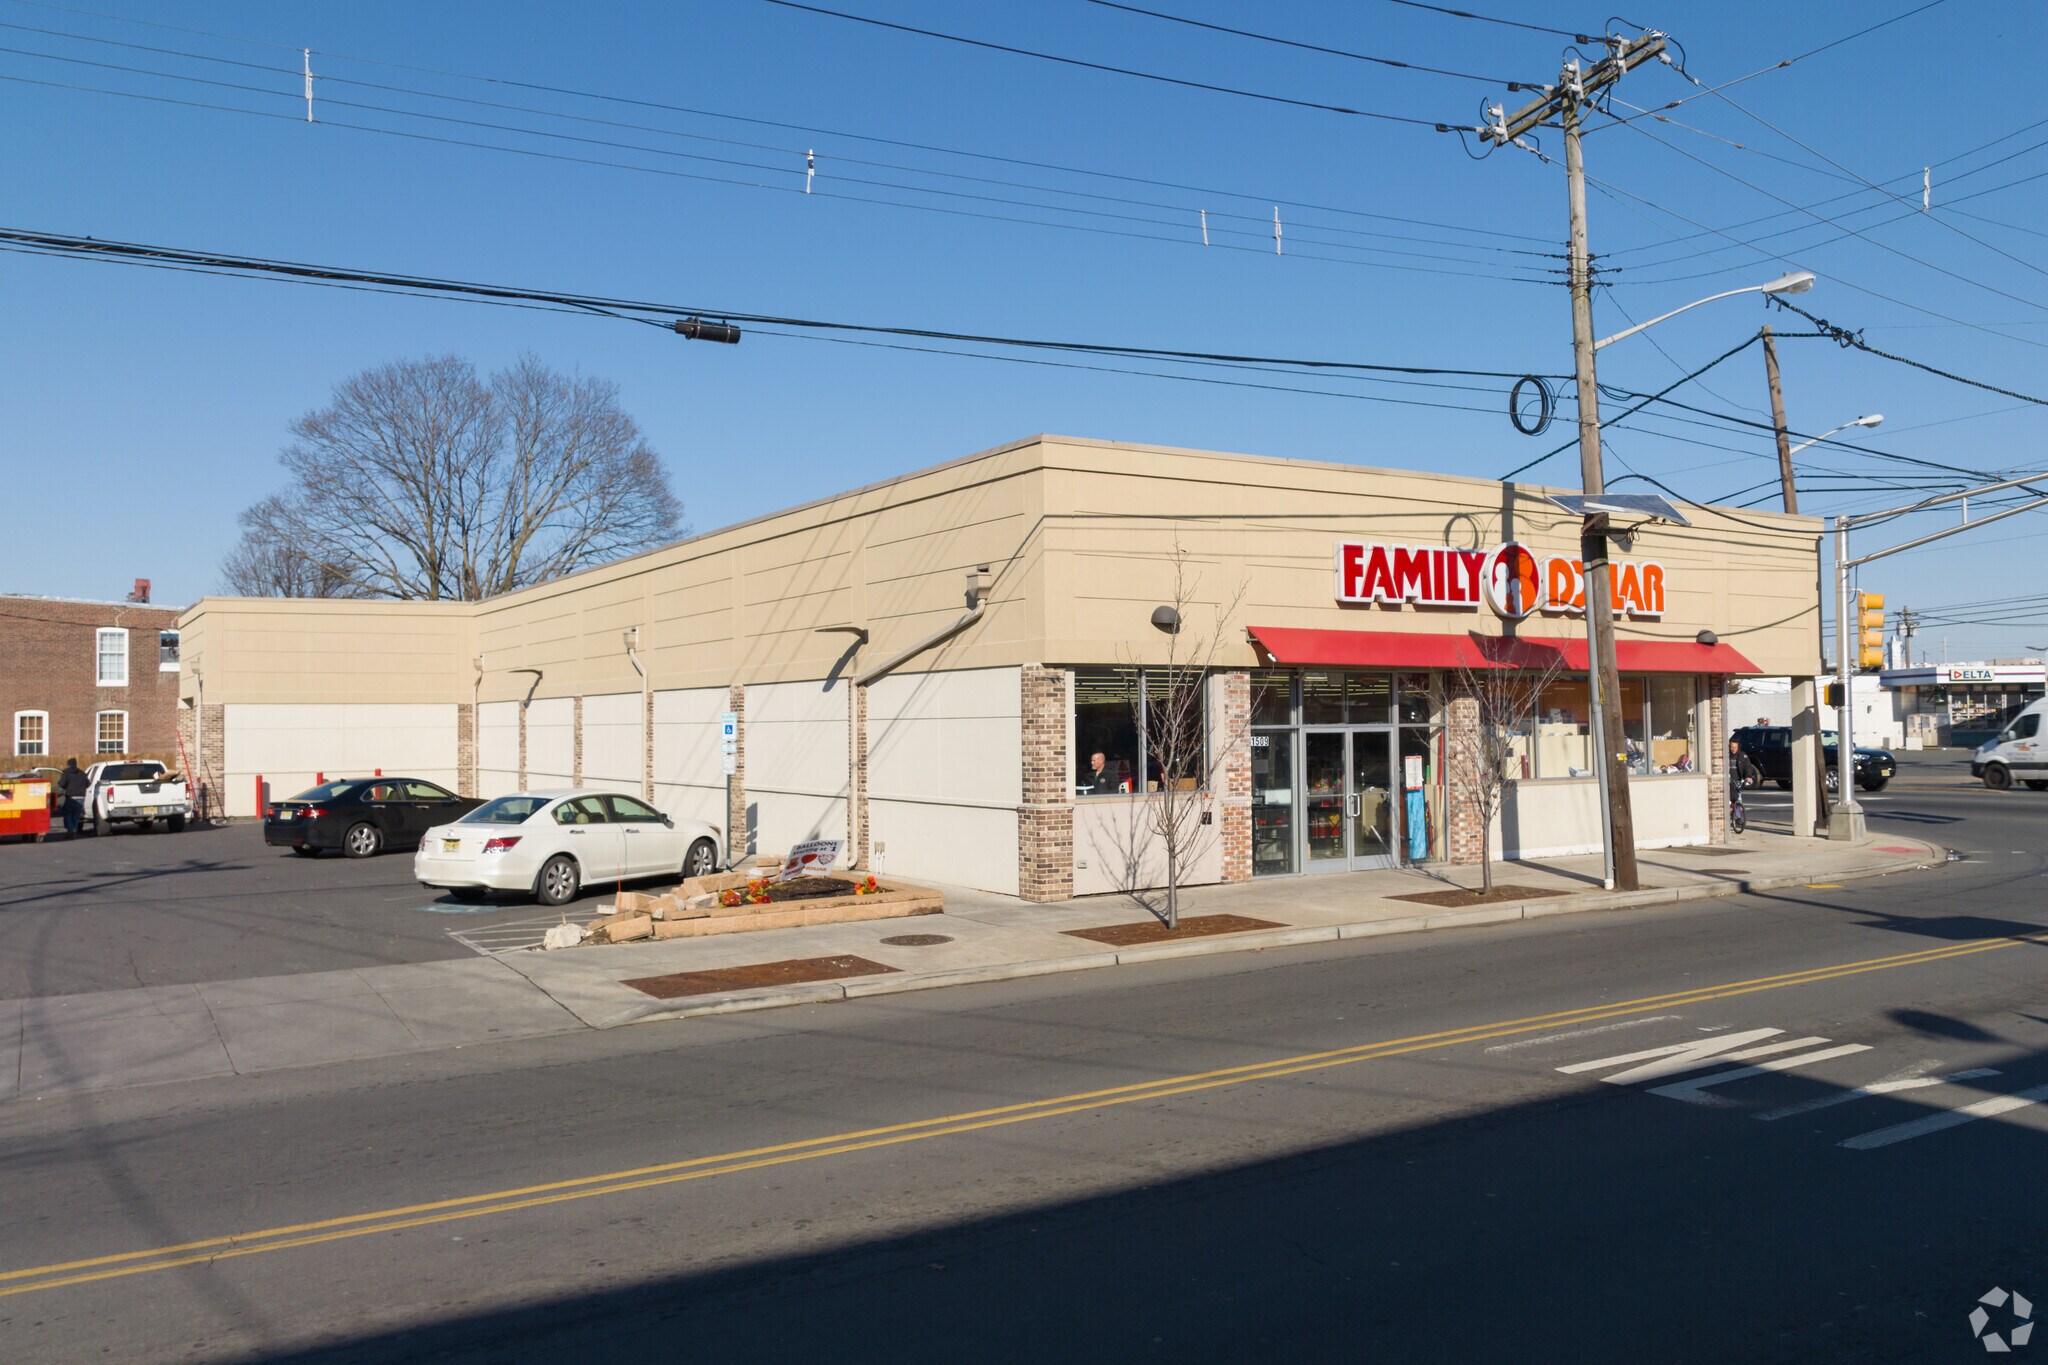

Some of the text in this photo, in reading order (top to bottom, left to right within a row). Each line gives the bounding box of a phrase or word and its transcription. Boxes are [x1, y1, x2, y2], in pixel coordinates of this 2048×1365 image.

[1342, 543, 1665, 612] FAMILY DOLAR
[1251, 736, 1269, 746] 1509
[796, 841, 838, 850] BALLOONS
